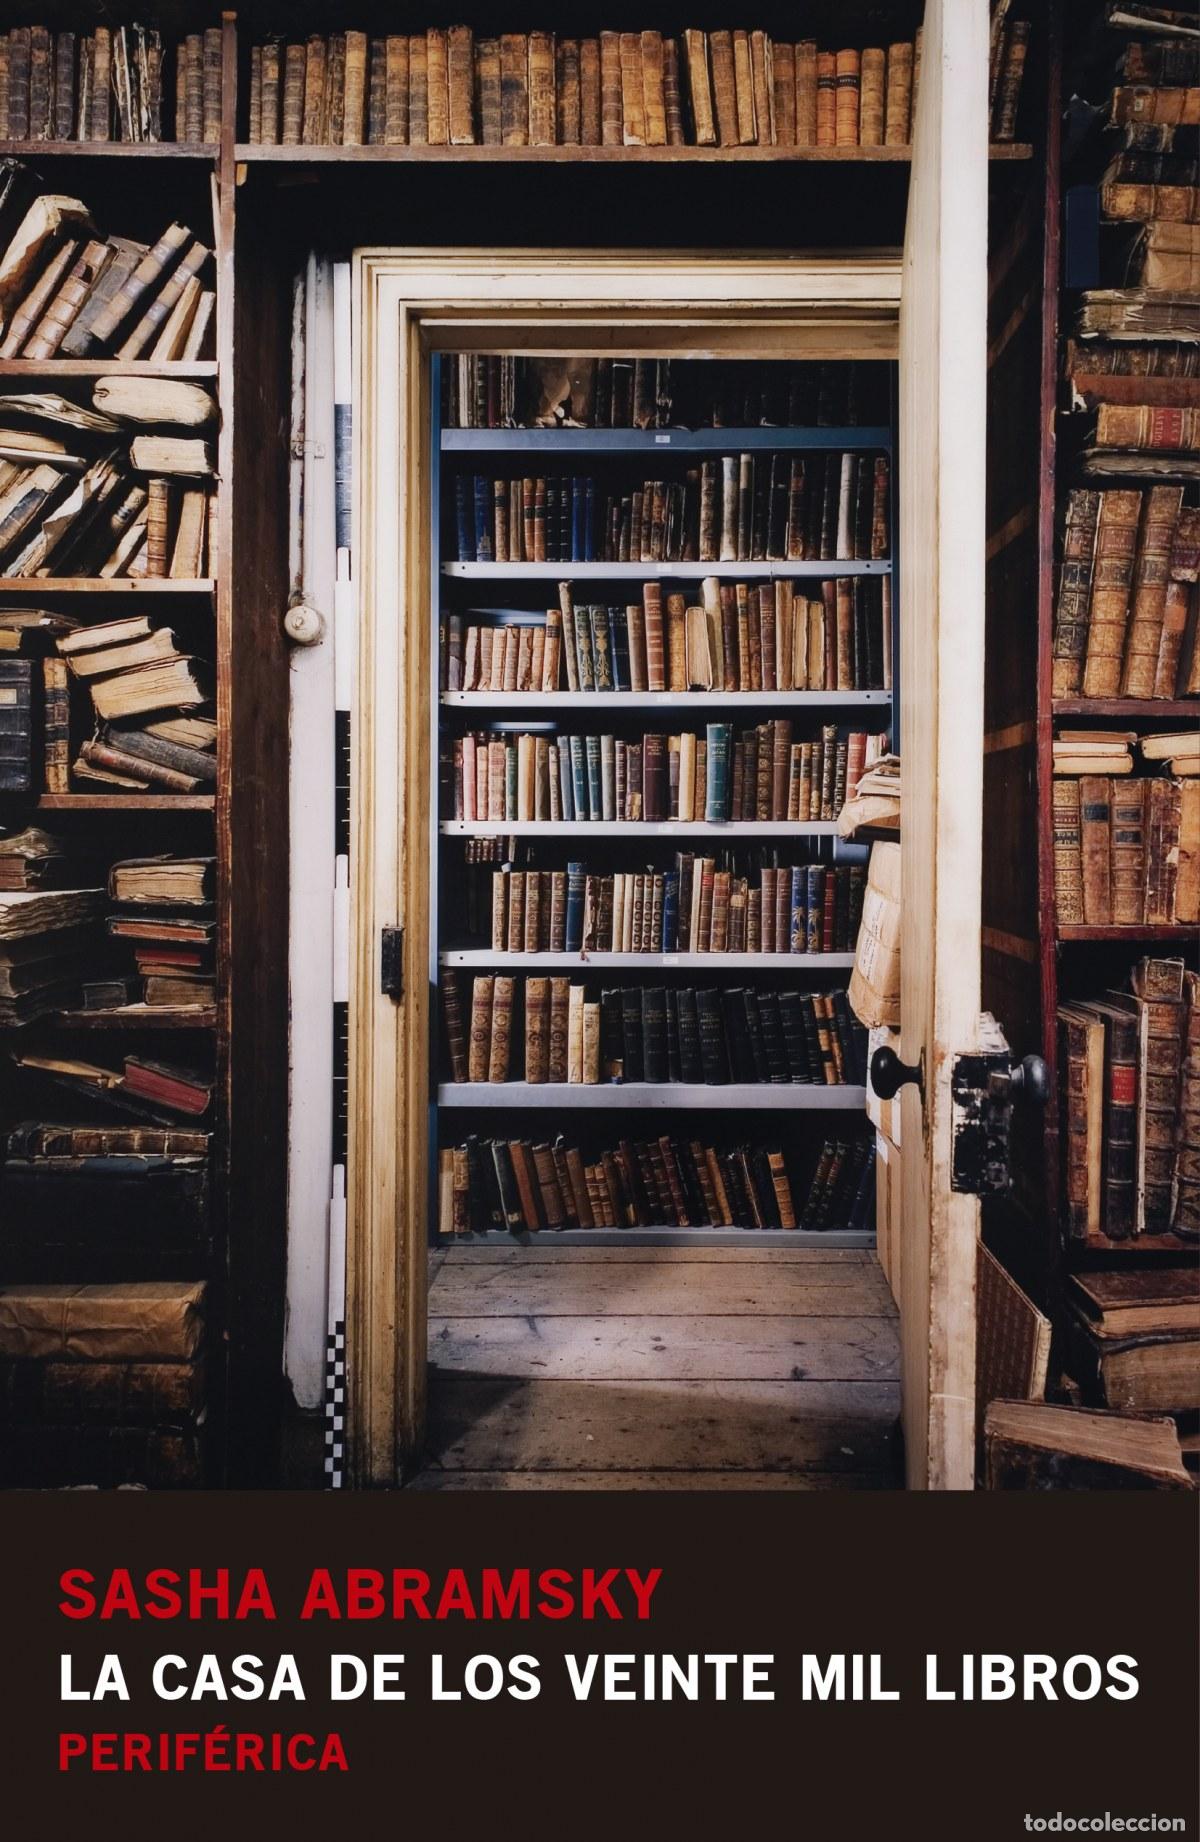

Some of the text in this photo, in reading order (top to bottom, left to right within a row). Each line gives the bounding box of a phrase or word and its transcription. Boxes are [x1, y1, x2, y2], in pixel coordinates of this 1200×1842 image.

[59, 1568, 662, 1620] SASHA ABRAMSKY
[61, 1654, 1140, 1701] LA CASA DE LOS VEINTE MIL LIBROS
[59, 1725, 349, 1771] PERIFÉRICA
